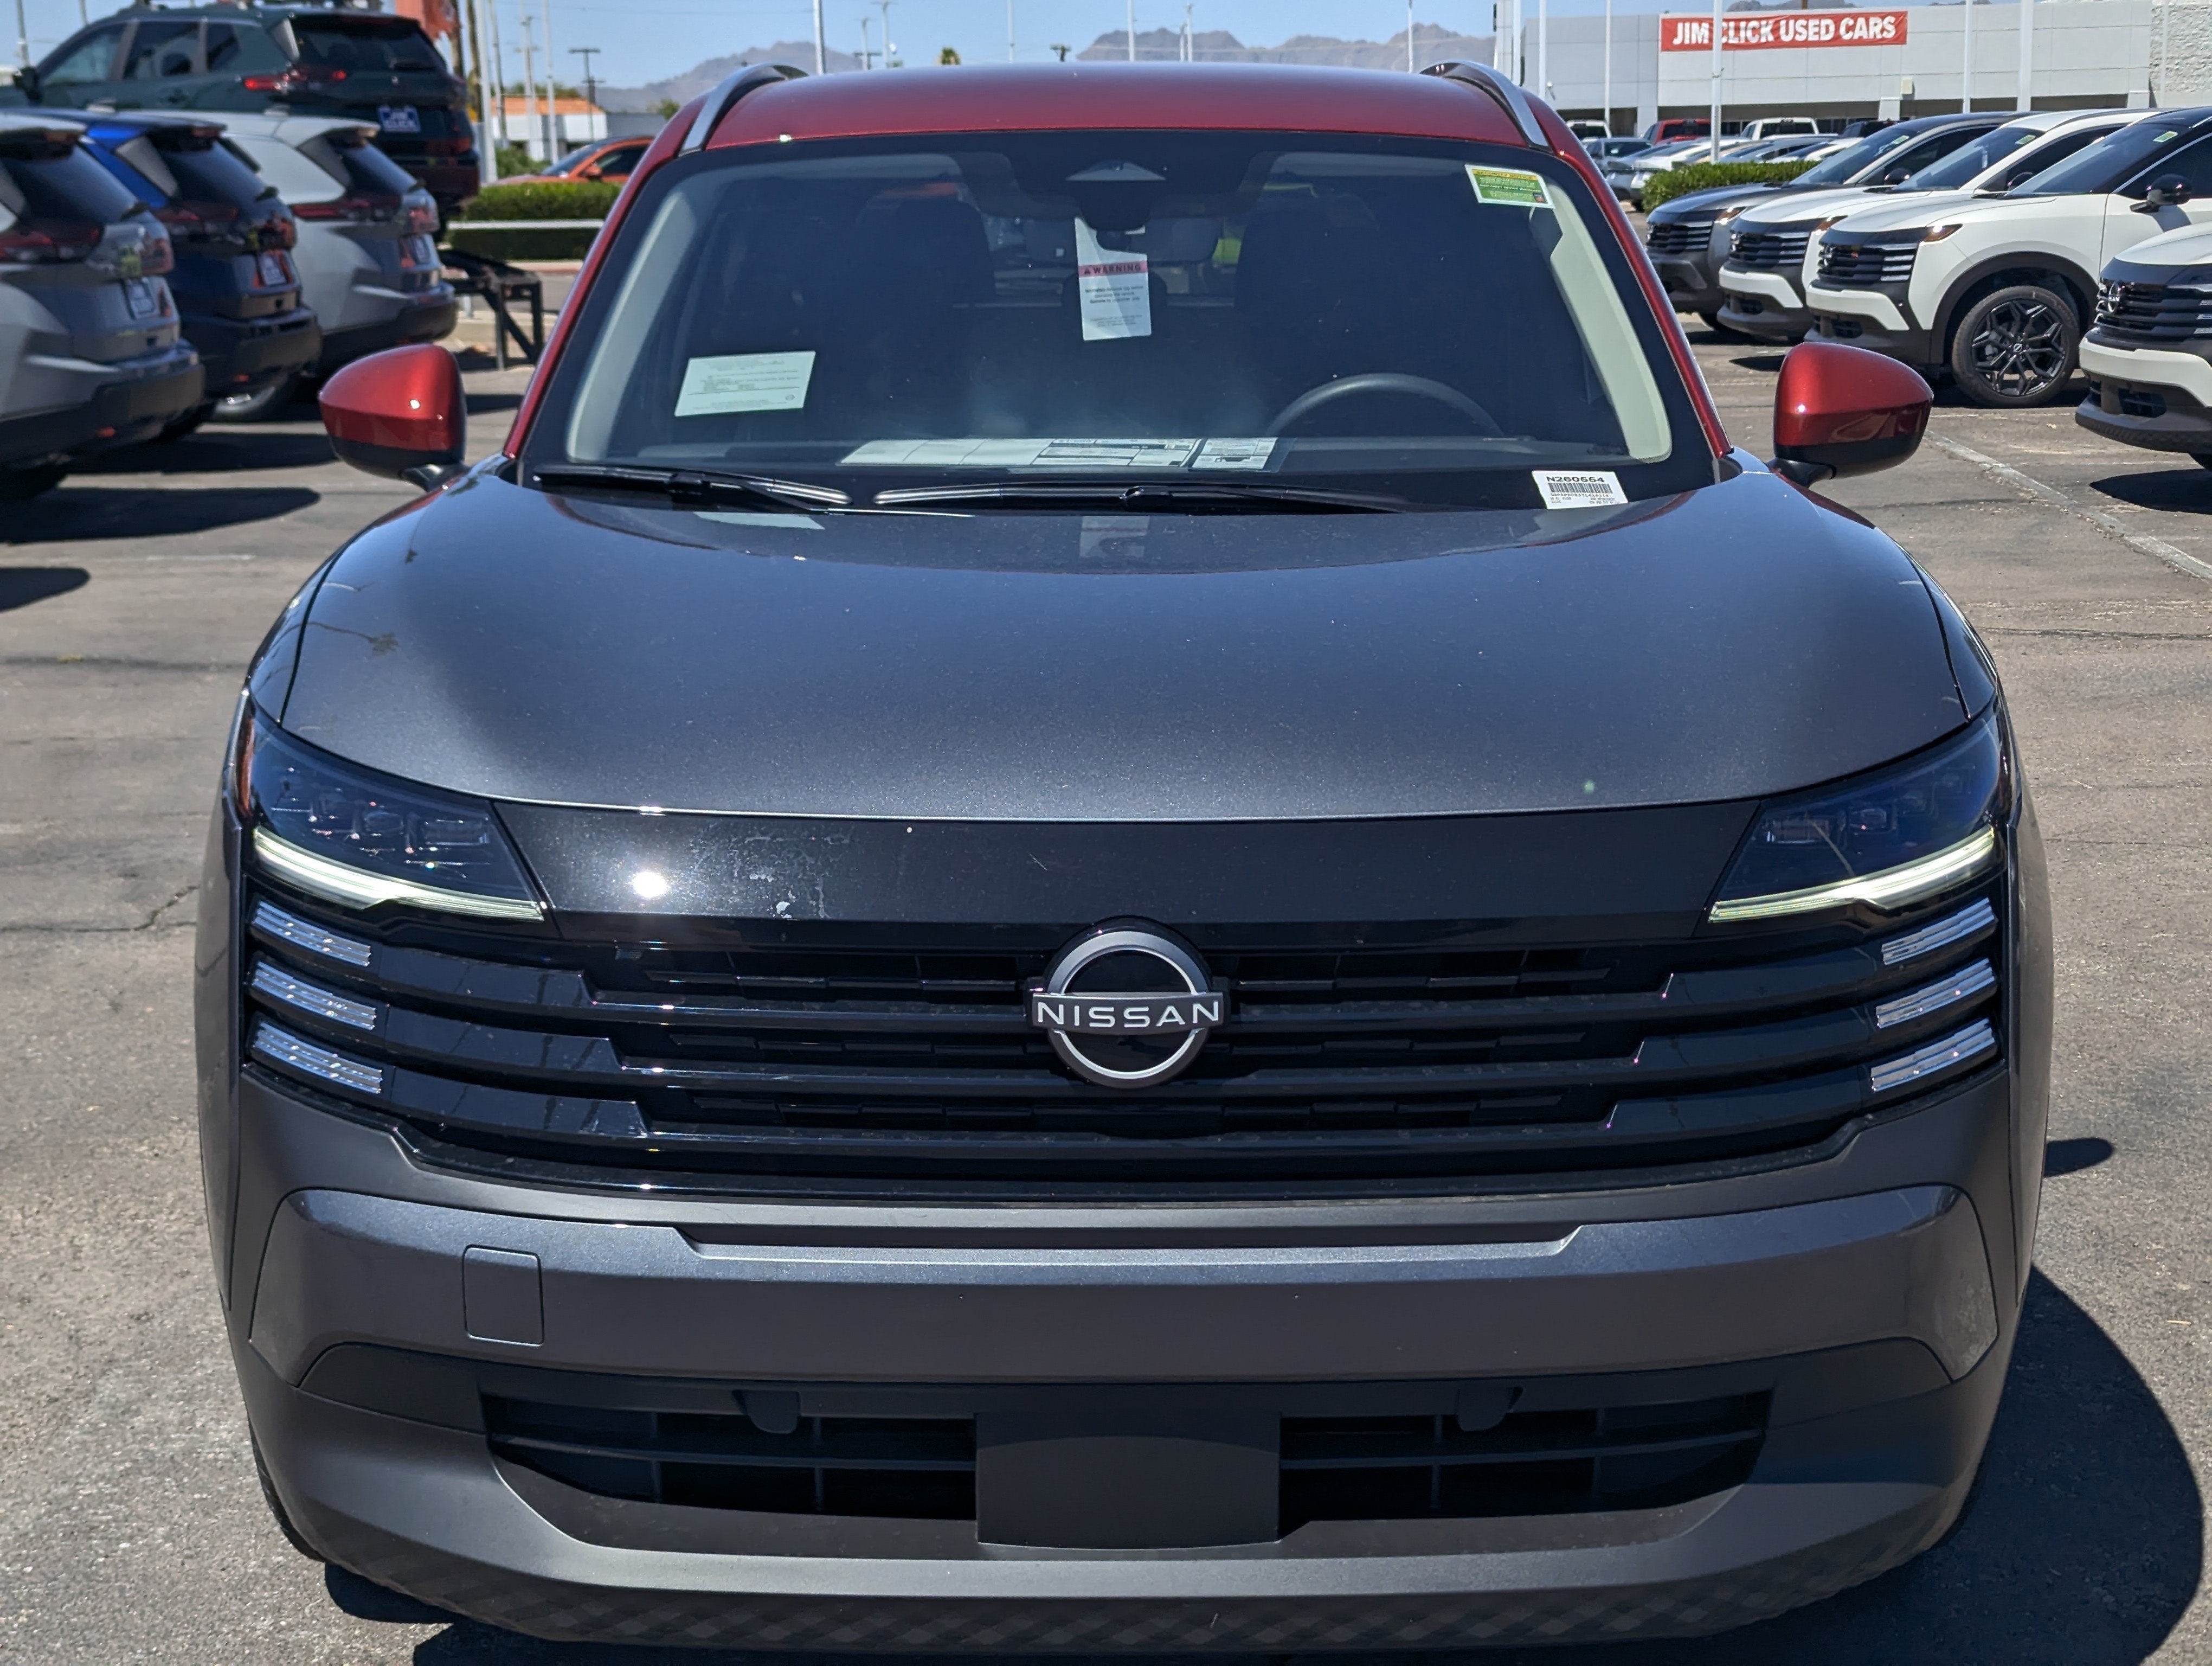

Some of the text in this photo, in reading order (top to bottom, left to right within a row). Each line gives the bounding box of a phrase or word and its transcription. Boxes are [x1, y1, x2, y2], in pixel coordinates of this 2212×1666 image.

[1672, 22, 1709, 45] JIM
[1779, 18, 1835, 42] USED
[1840, 16, 1896, 40] CARS
[1093, 264, 1141, 274] WARNING
[1037, 1000, 1219, 1028] NISSAN
